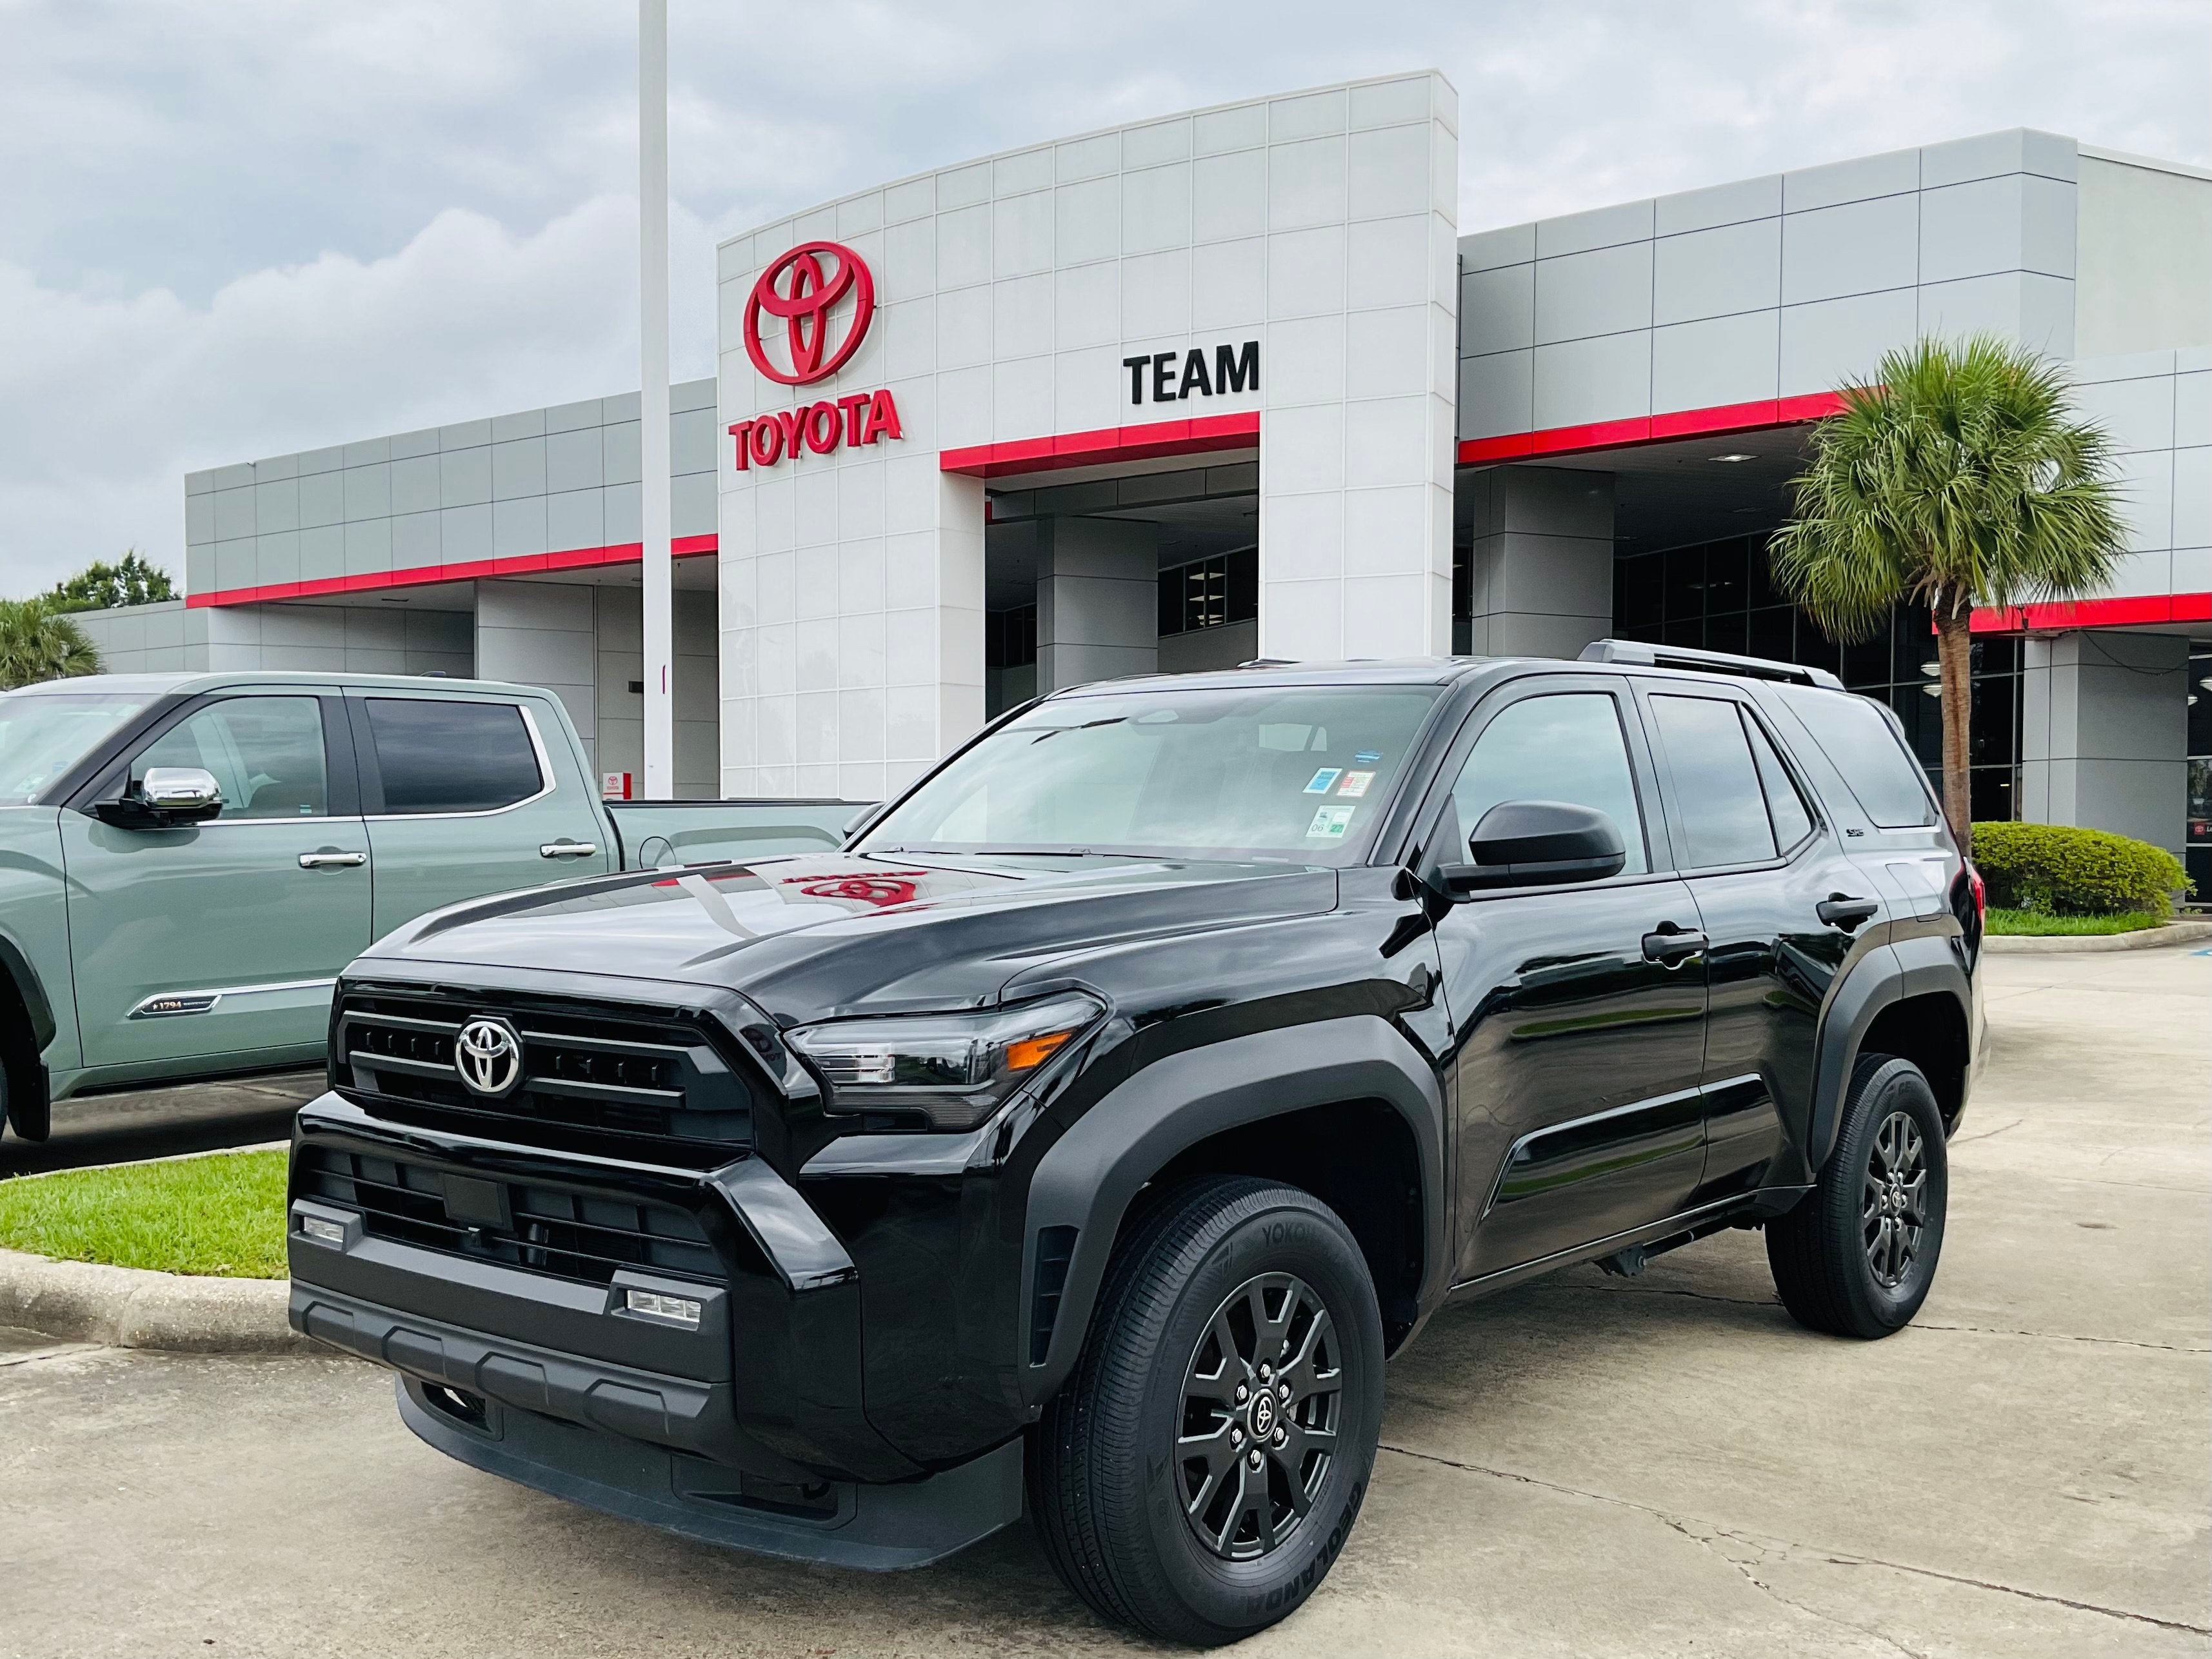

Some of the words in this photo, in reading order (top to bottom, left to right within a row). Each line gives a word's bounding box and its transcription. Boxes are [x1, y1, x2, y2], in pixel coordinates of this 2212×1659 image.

[1122, 341, 1259, 404] TEAM
[728, 389, 903, 471] TOYOTA
[1330, 824, 1344, 833] 27
[159, 1001, 182, 1009] 1794
